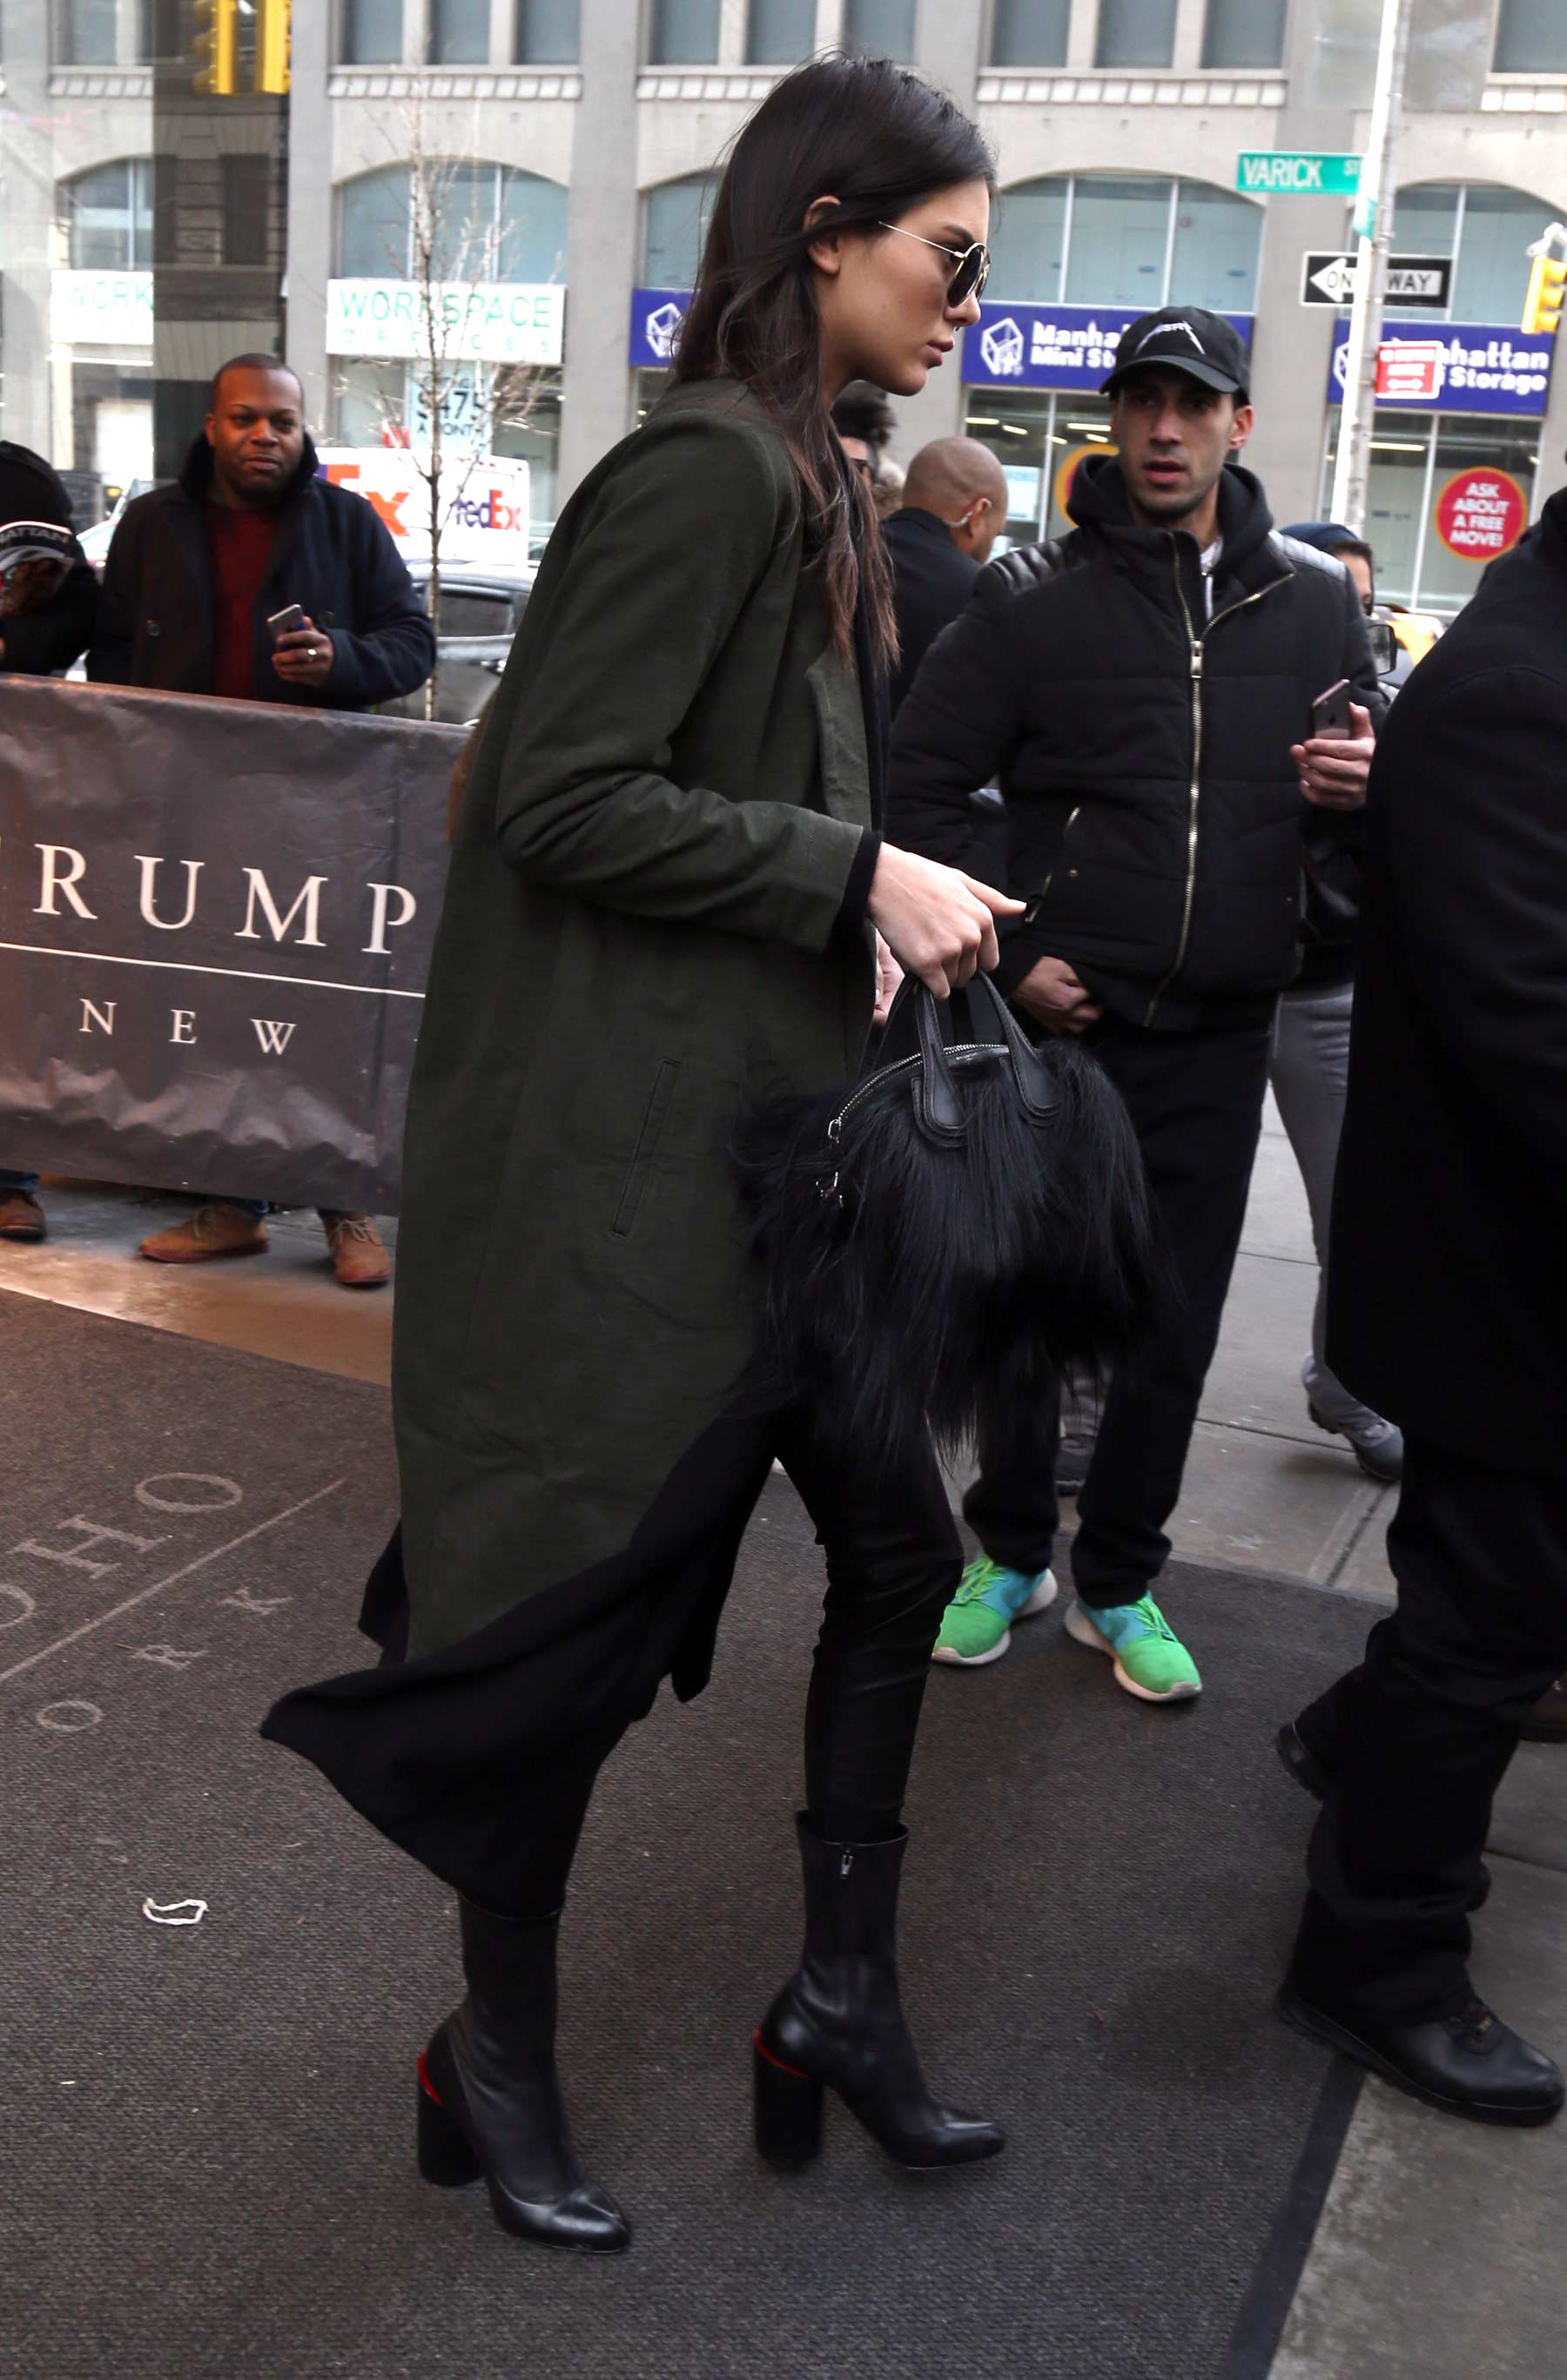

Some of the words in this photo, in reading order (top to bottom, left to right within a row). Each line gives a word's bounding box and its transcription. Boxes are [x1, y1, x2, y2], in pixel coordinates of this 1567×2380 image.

[1243, 158, 1322, 188] VARICK
[1326, 271, 1353, 289] ON
[1388, 272, 1432, 292] WAY
[340, 290, 551, 328] WORKSPACE
[1032, 319, 1131, 349] Manha
[1031, 346, 1084, 367] Mini
[1449, 366, 1547, 395] Storage
[1466, 481, 1500, 498] ASK
[1452, 497, 1510, 515] ABOUT
[1452, 514, 1467, 528] A
[1469, 514, 1504, 532] FREE
[0, 836, 417, 954] RUMP
[78, 998, 297, 1055] NEW
